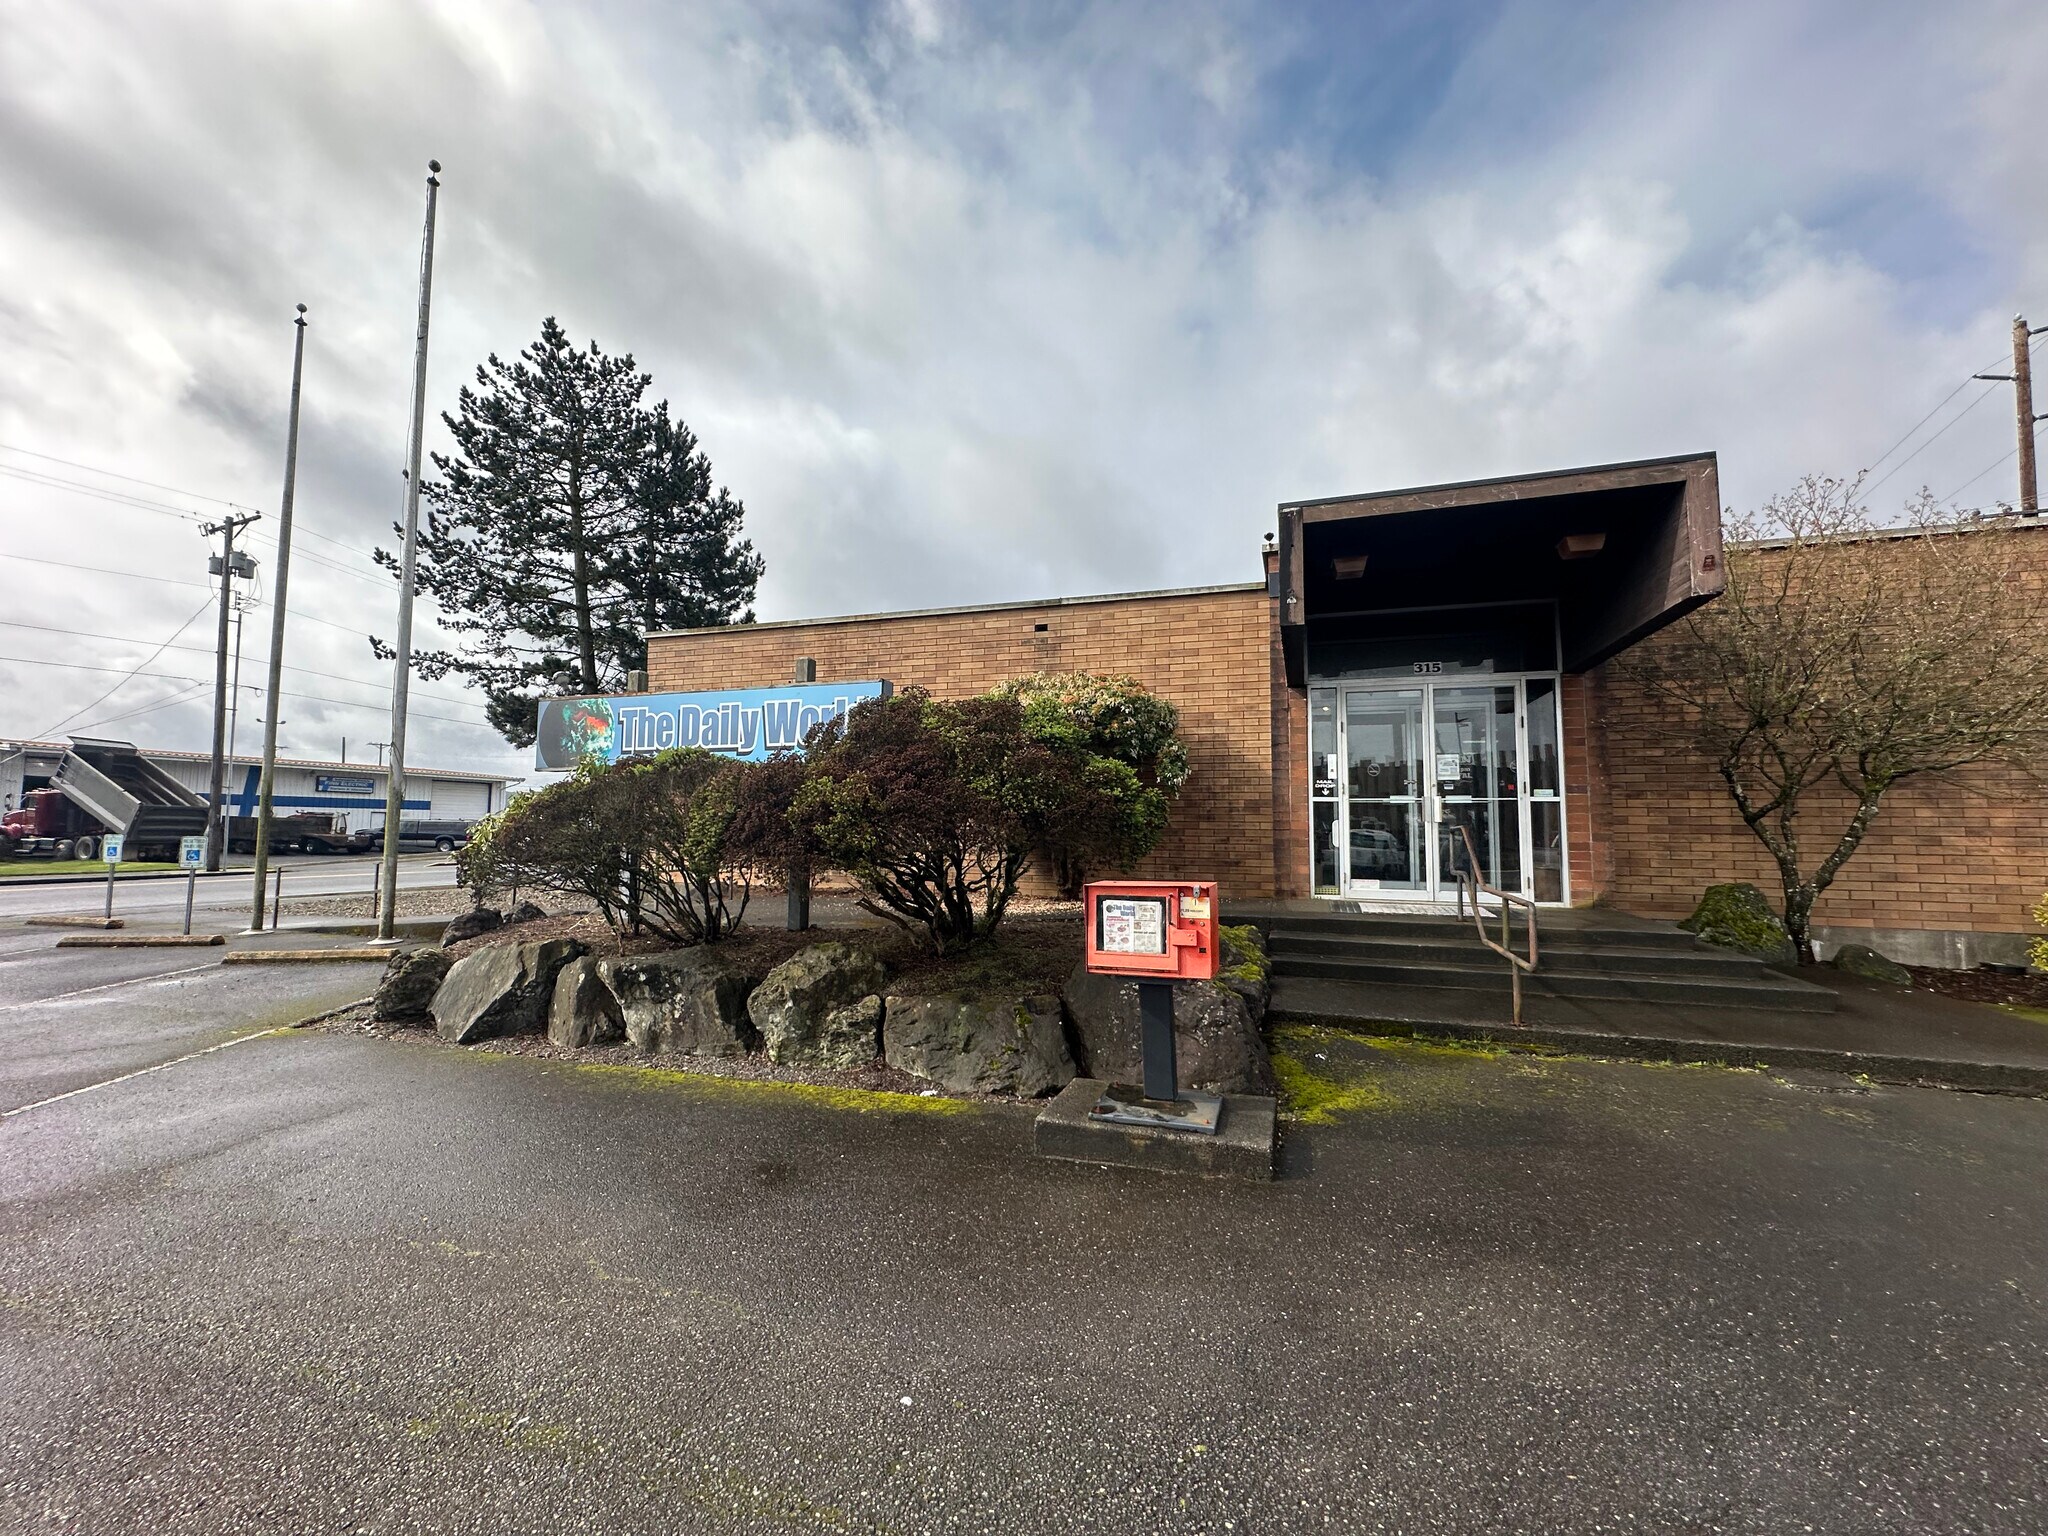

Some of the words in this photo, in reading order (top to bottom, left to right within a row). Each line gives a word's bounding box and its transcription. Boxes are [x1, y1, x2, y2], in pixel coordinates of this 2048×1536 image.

[1414, 663, 1441, 673] 315
[620, 707, 675, 752] The
[679, 701, 760, 754] Daily
[763, 695, 868, 750] Worl
